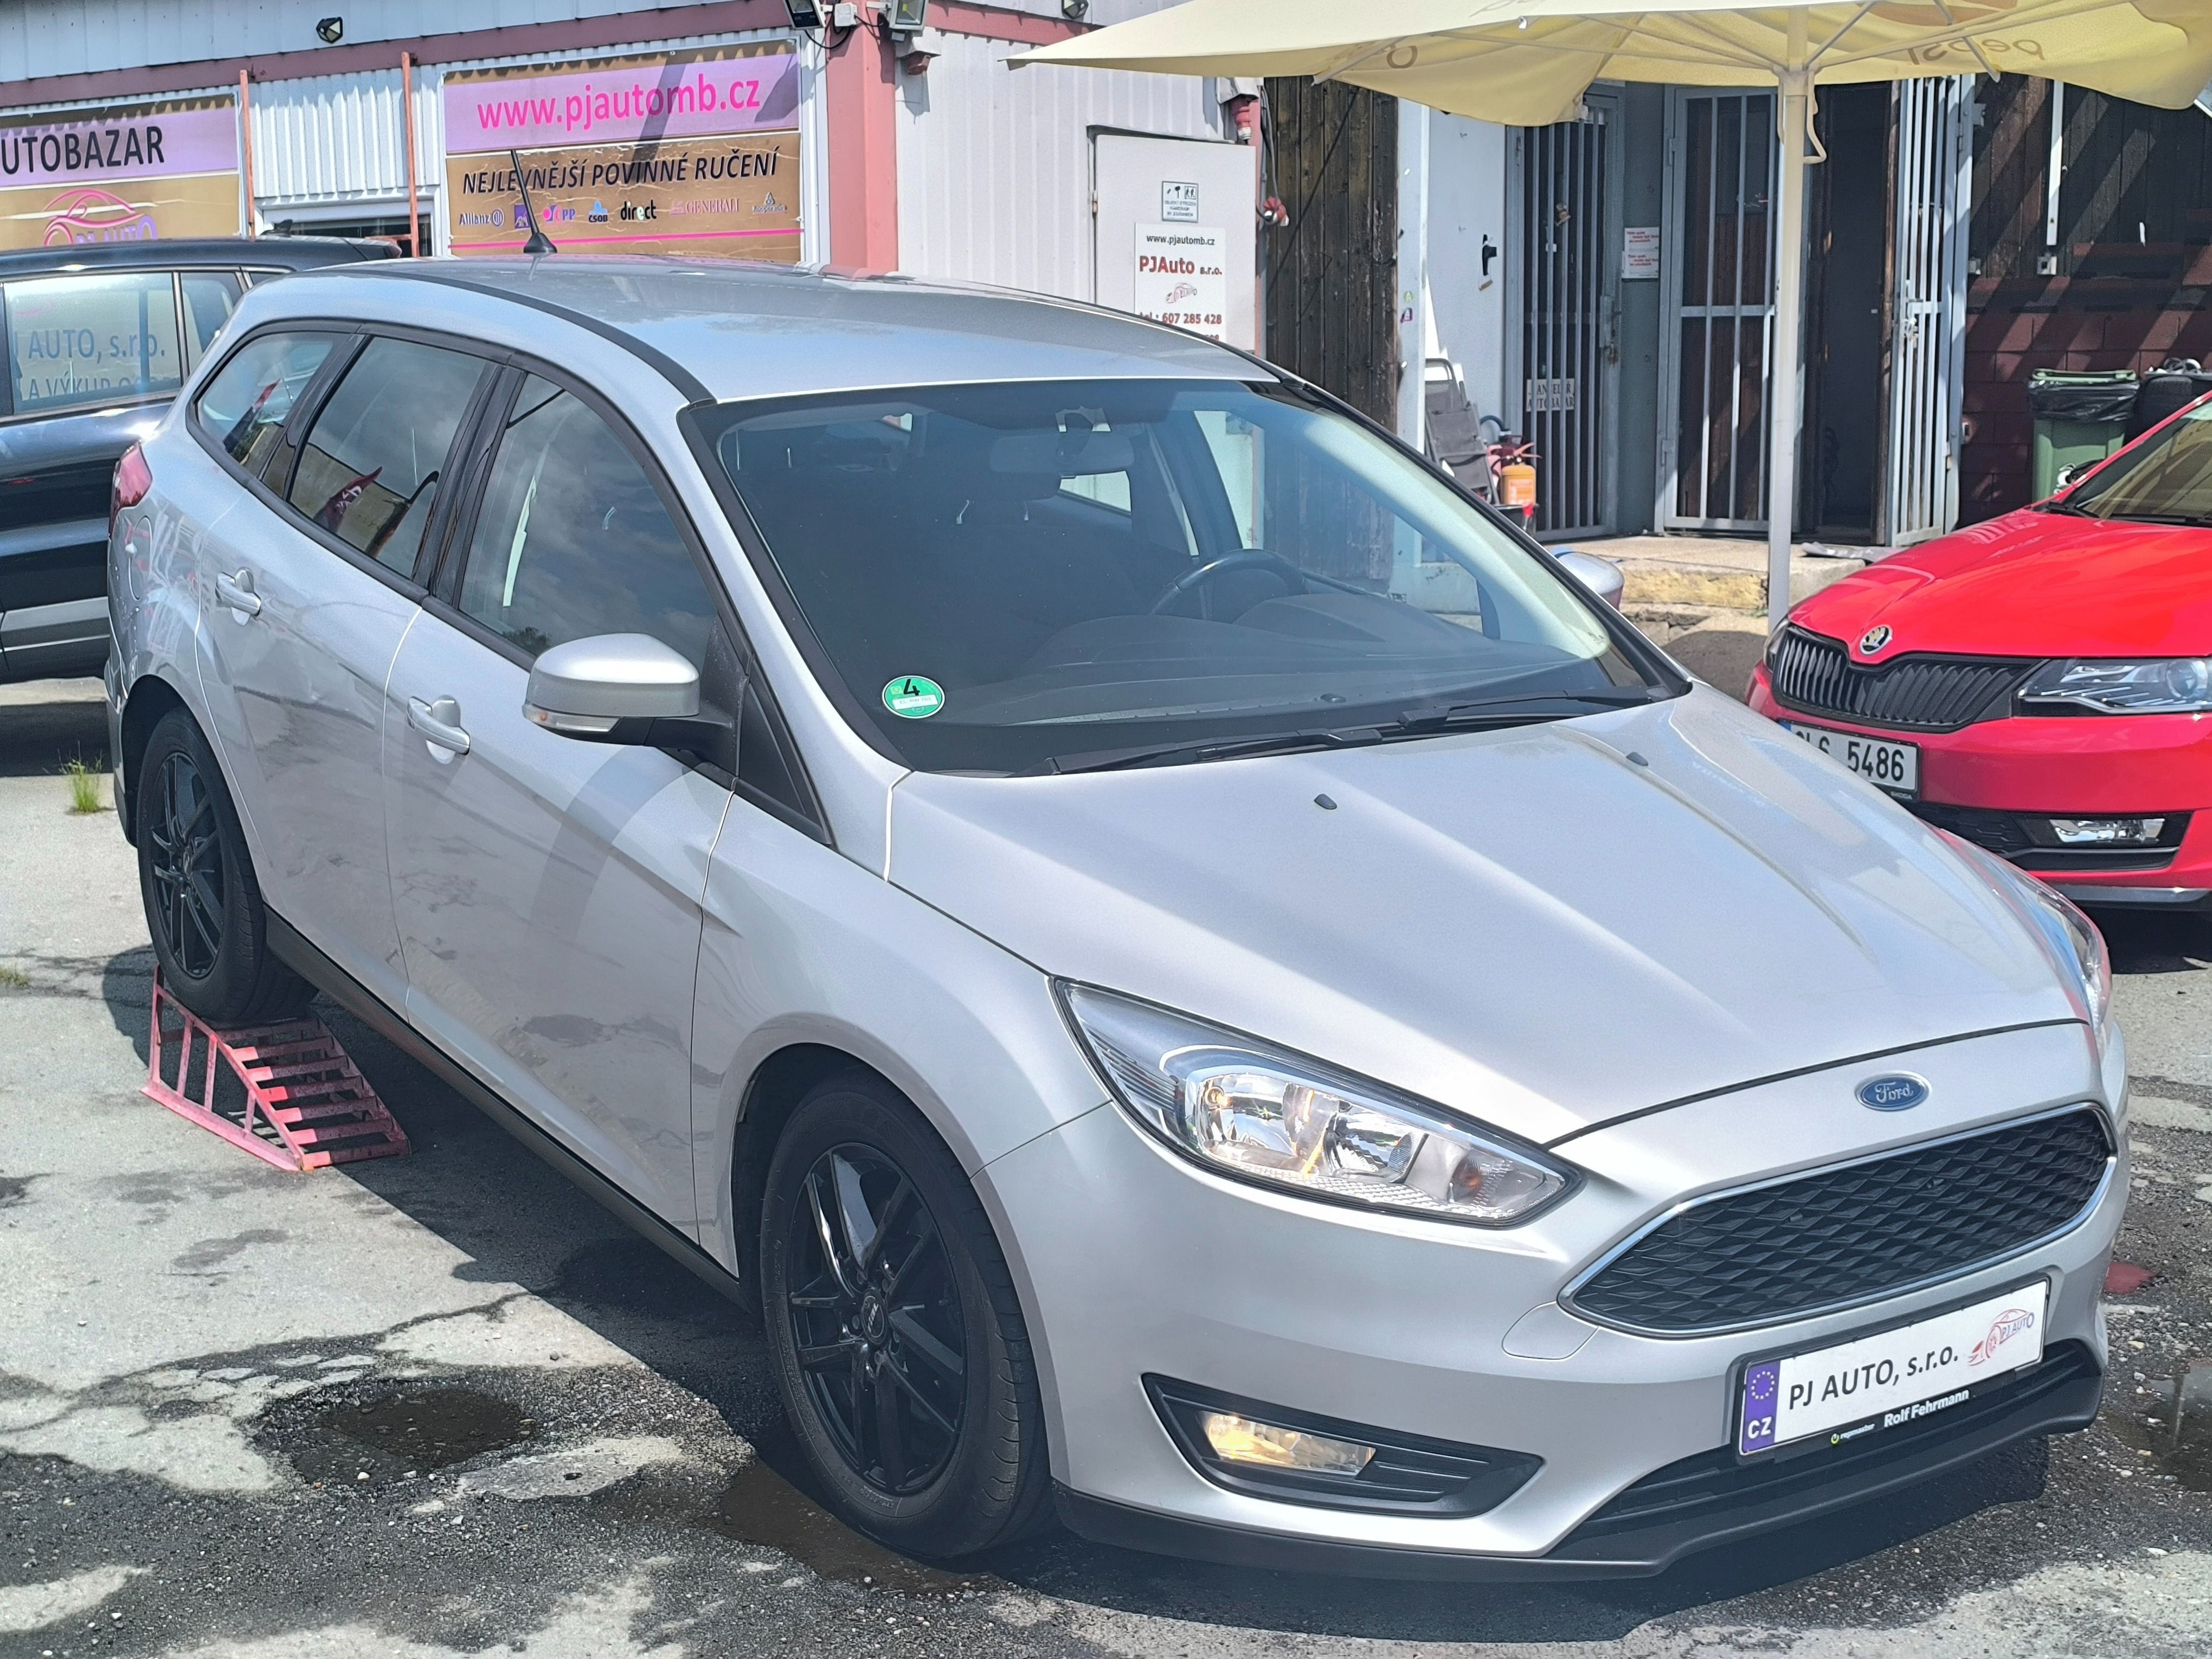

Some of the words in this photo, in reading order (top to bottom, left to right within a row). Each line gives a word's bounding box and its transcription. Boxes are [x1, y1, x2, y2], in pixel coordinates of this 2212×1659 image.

[478, 74, 761, 131] www.pjautomb.cz
[463, 159, 587, 194] NEJLEVNĚJŠÍ
[592, 152, 688, 185] POVINNÉ
[695, 146, 780, 179] RUČENÍ
[620, 200, 657, 221] direct
[1146, 235, 1215, 246] www.pjautomb.cz
[1139, 255, 1195, 274] PJAuto
[1162, 312, 1180, 325] 607
[1184, 313, 1201, 324] 285
[1204, 313, 1221, 324] 428
[28, 328, 102, 364] AUTO,
[903, 678, 920, 696] 4
[1848, 740, 1905, 782] 5486
[1874, 1082, 1914, 1103] Ford
[1789, 1380, 1812, 1410] PJ
[1821, 1359, 1899, 1401] AUTO,
[1907, 1346, 1959, 1377] s.r.o.
[1884, 1407, 1910, 1427] Rolf
[1911, 1389, 1970, 1419] Fehrmann
[1747, 1416, 1773, 1440] CZ
